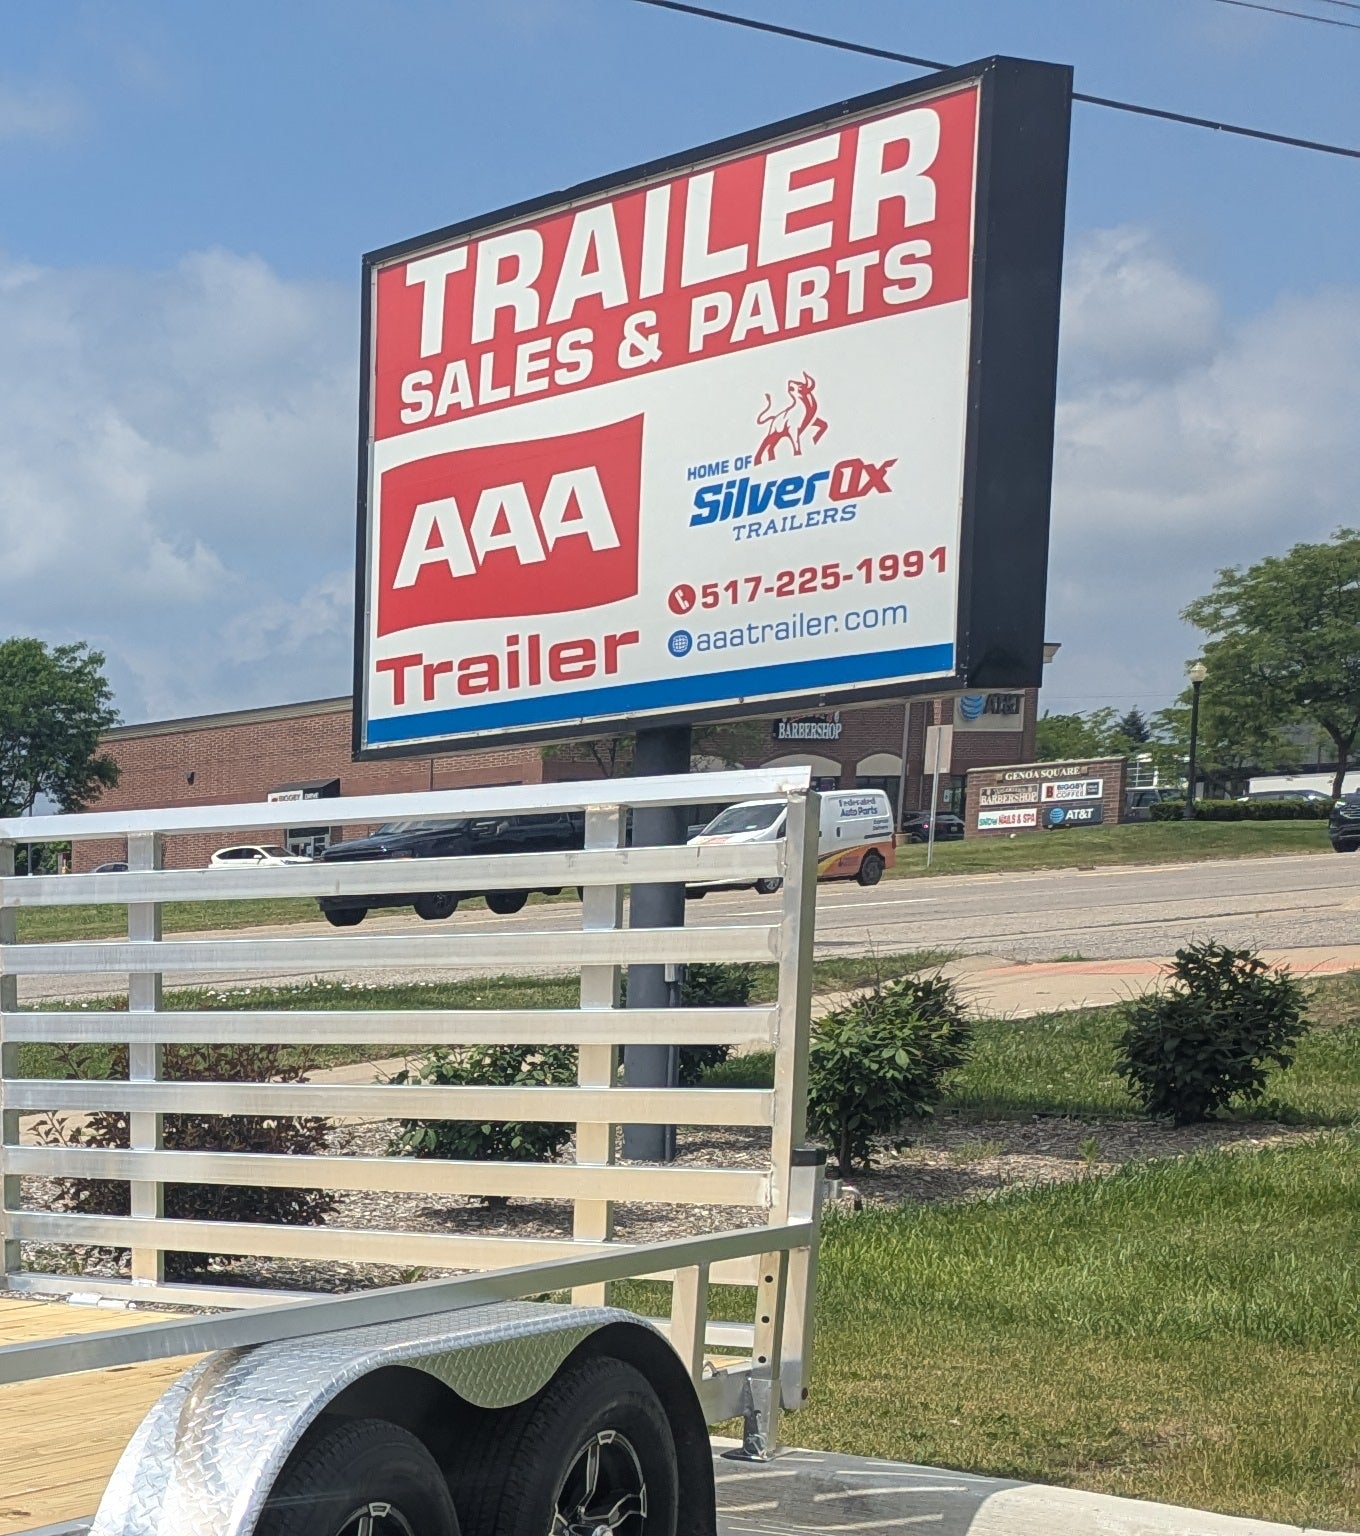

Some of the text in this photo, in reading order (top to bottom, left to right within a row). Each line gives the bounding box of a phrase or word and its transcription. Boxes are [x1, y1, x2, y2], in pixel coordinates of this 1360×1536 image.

[405, 106, 941, 358] TRAILER
[400, 239, 933, 424] SALES & PARTS
[687, 454, 753, 481] HOME OF
[392, 466, 621, 590] AAA
[732, 503, 857, 541] TRAILERS
[701, 546, 947, 609] 517-225-1991
[696, 604, 908, 651] aaatrailer.com
[377, 630, 640, 706] Trailer
[983, 693, 1020, 714] AT&T
[778, 722, 842, 739] BARBERSHOP
[1005, 767, 1080, 780] GENOA SQUARE
[840, 806, 877, 817] Auto Parts
[980, 792, 1038, 804] BARBERSHOP
[1065, 808, 1094, 820] AT&T
